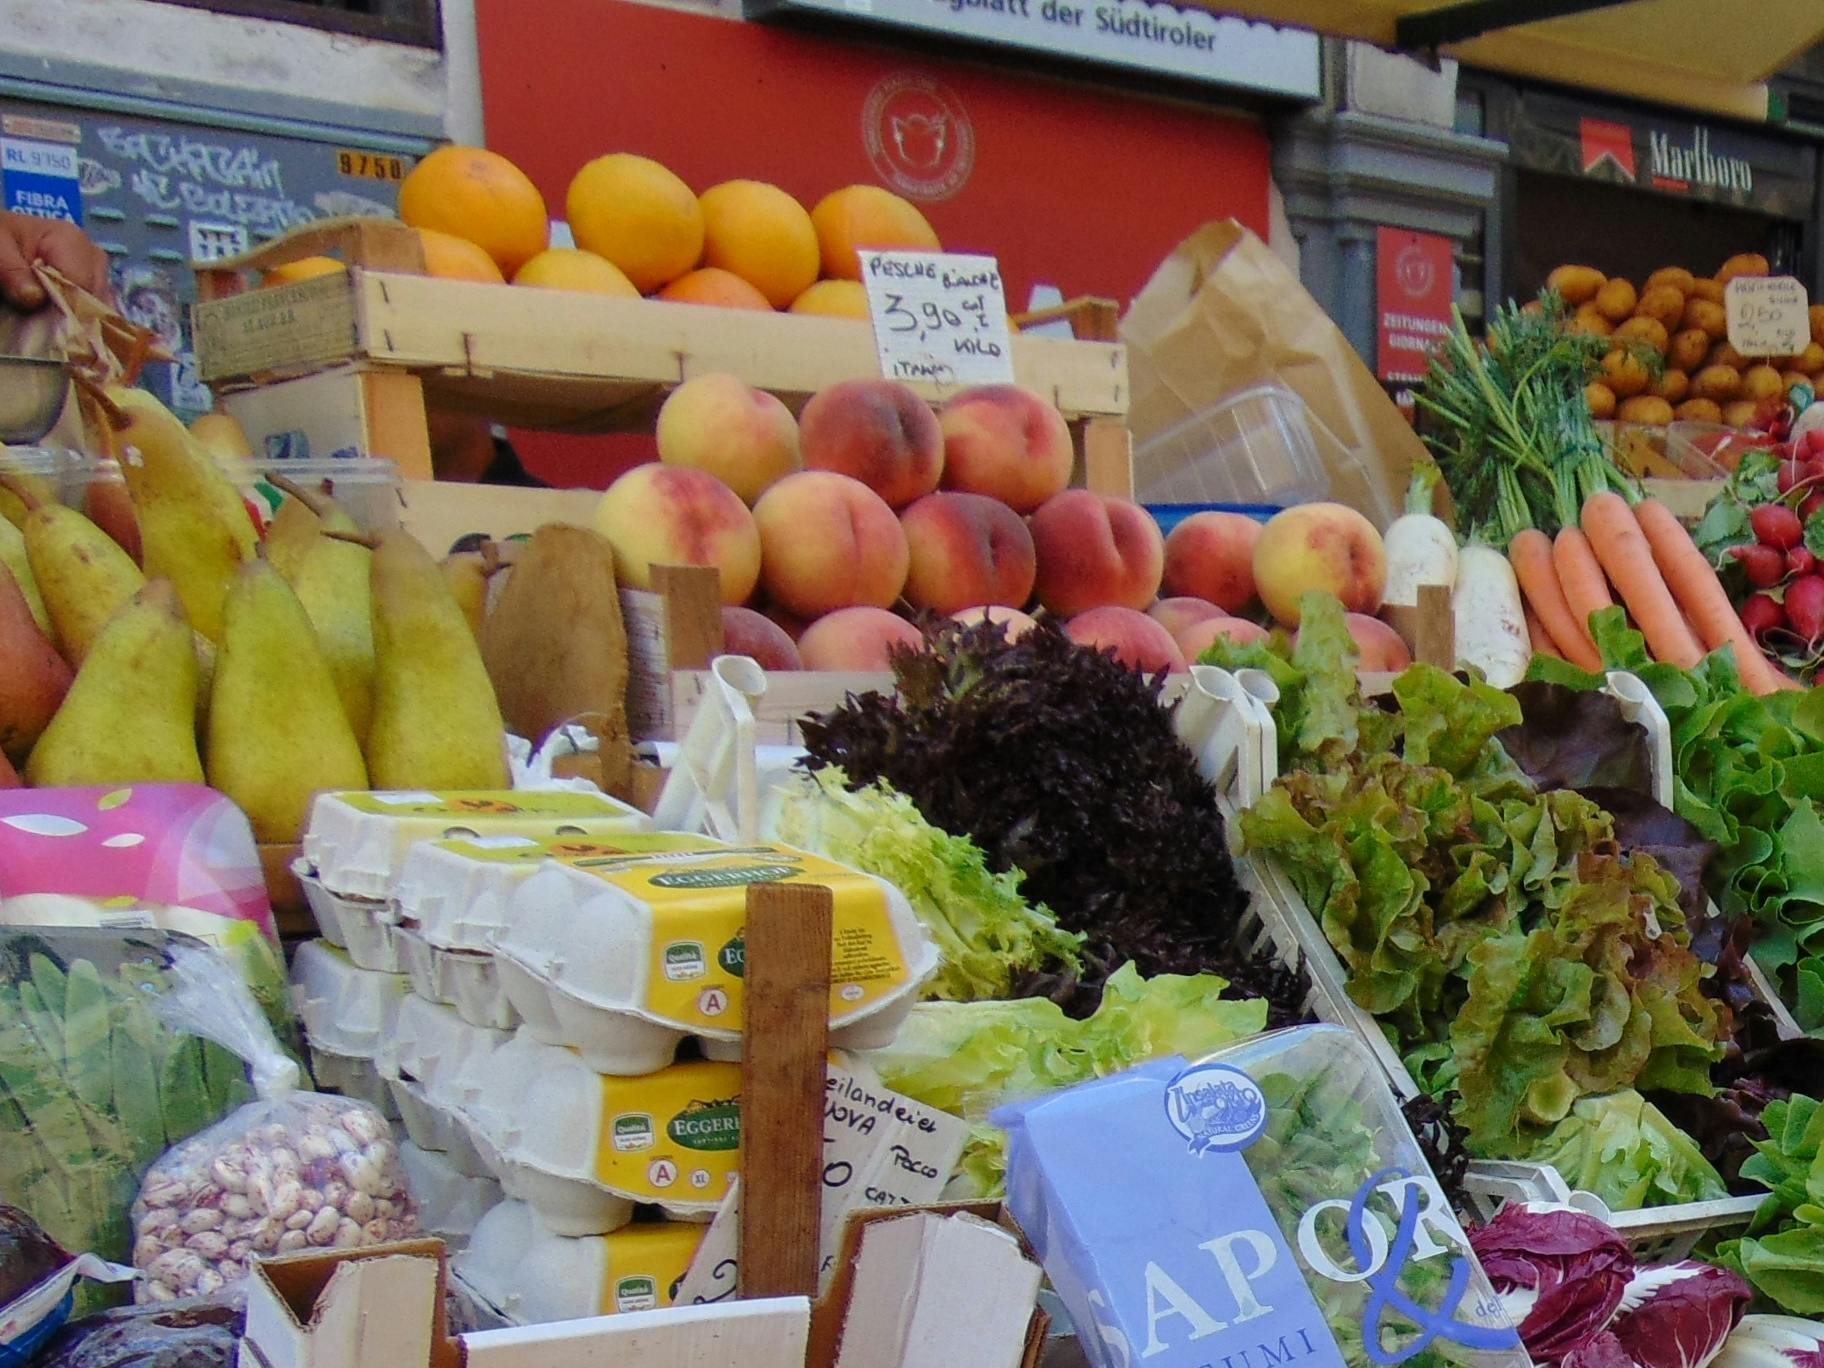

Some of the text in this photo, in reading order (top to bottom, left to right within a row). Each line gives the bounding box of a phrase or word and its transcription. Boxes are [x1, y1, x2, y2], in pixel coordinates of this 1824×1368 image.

[1041, 2, 1084, 27] der
[1095, 8, 1217, 52] Südtiroler
[1650, 124, 1753, 192] Marlboro
[16, 189, 69, 212] FIBRA
[883, 292, 962, 342] 3,90
[706, 993, 721, 1012] A
[655, 1163, 673, 1184] A
